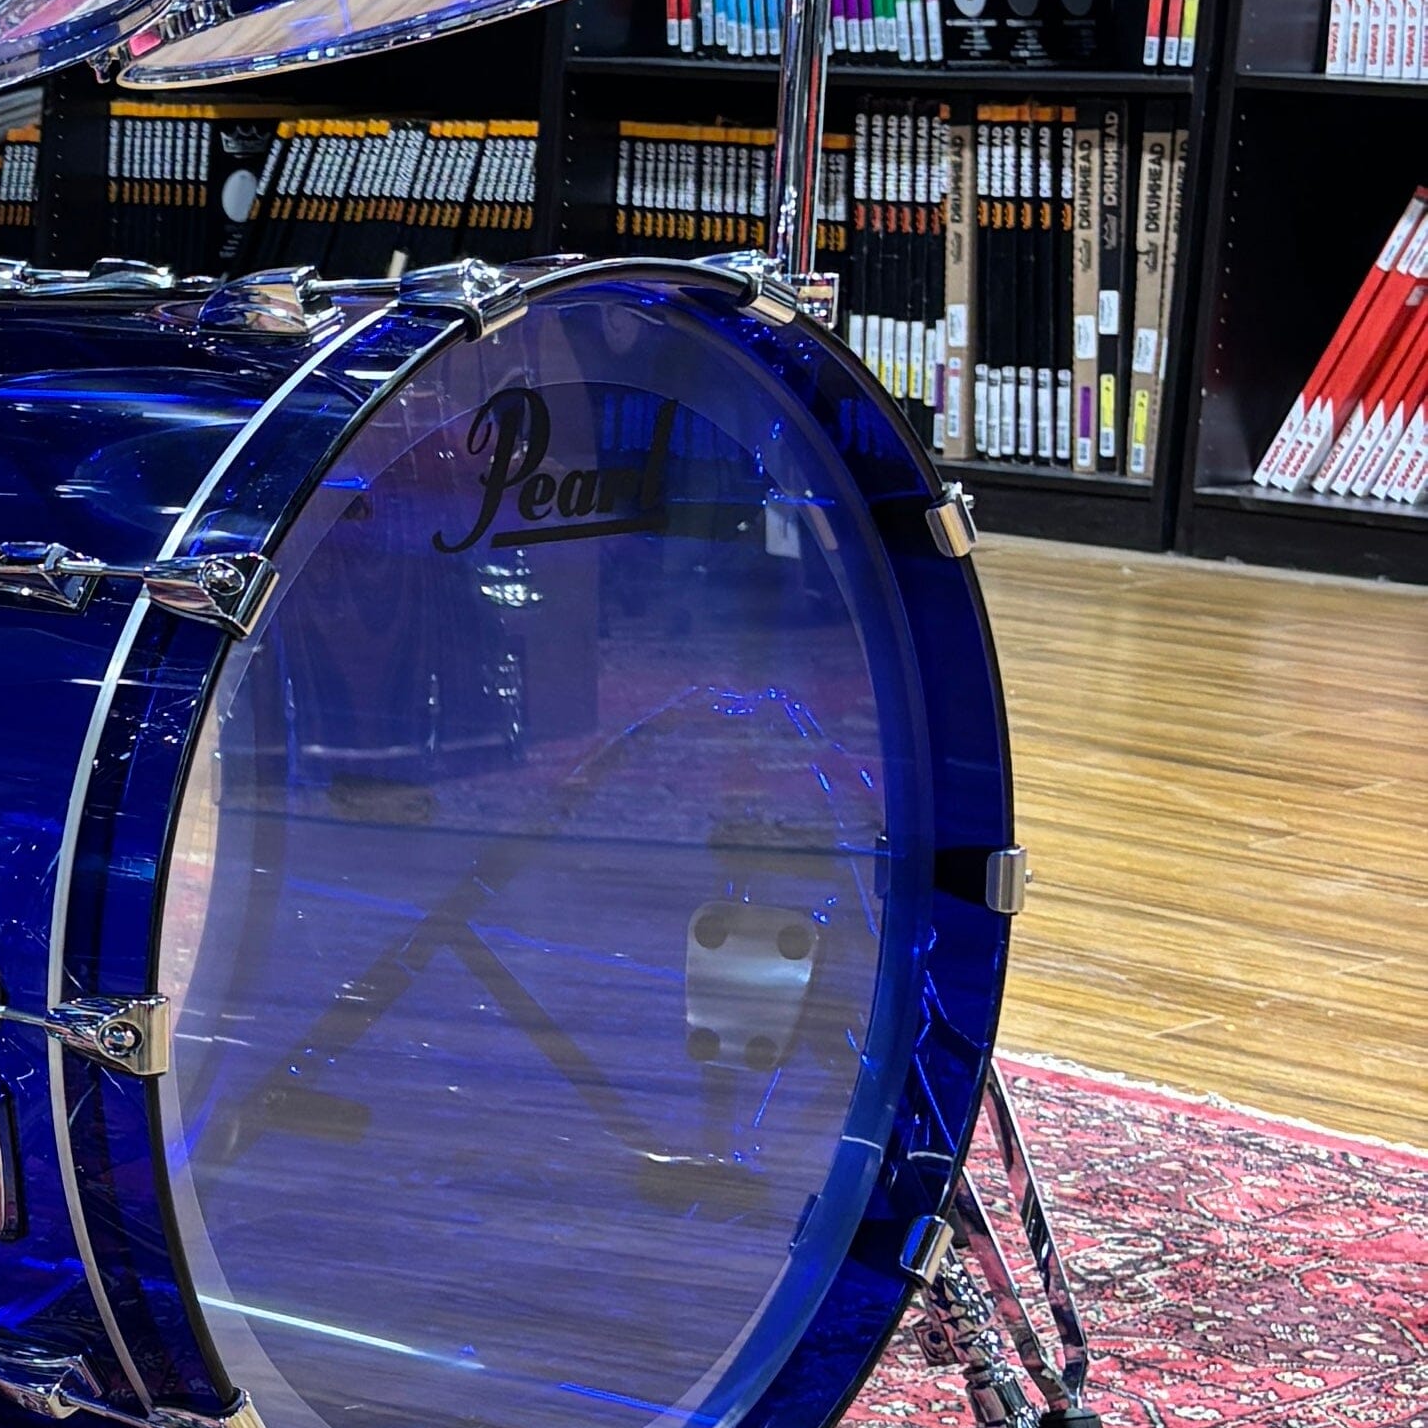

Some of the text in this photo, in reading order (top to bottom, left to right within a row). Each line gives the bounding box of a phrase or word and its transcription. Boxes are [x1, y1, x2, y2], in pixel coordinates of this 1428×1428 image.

[1079, 139, 1092, 230] DRUMHEAD
[1104, 111, 1119, 206] DRUMHEAD
[1146, 143, 1165, 233] DRUMHEAD
[431, 386, 679, 555] Pearl
